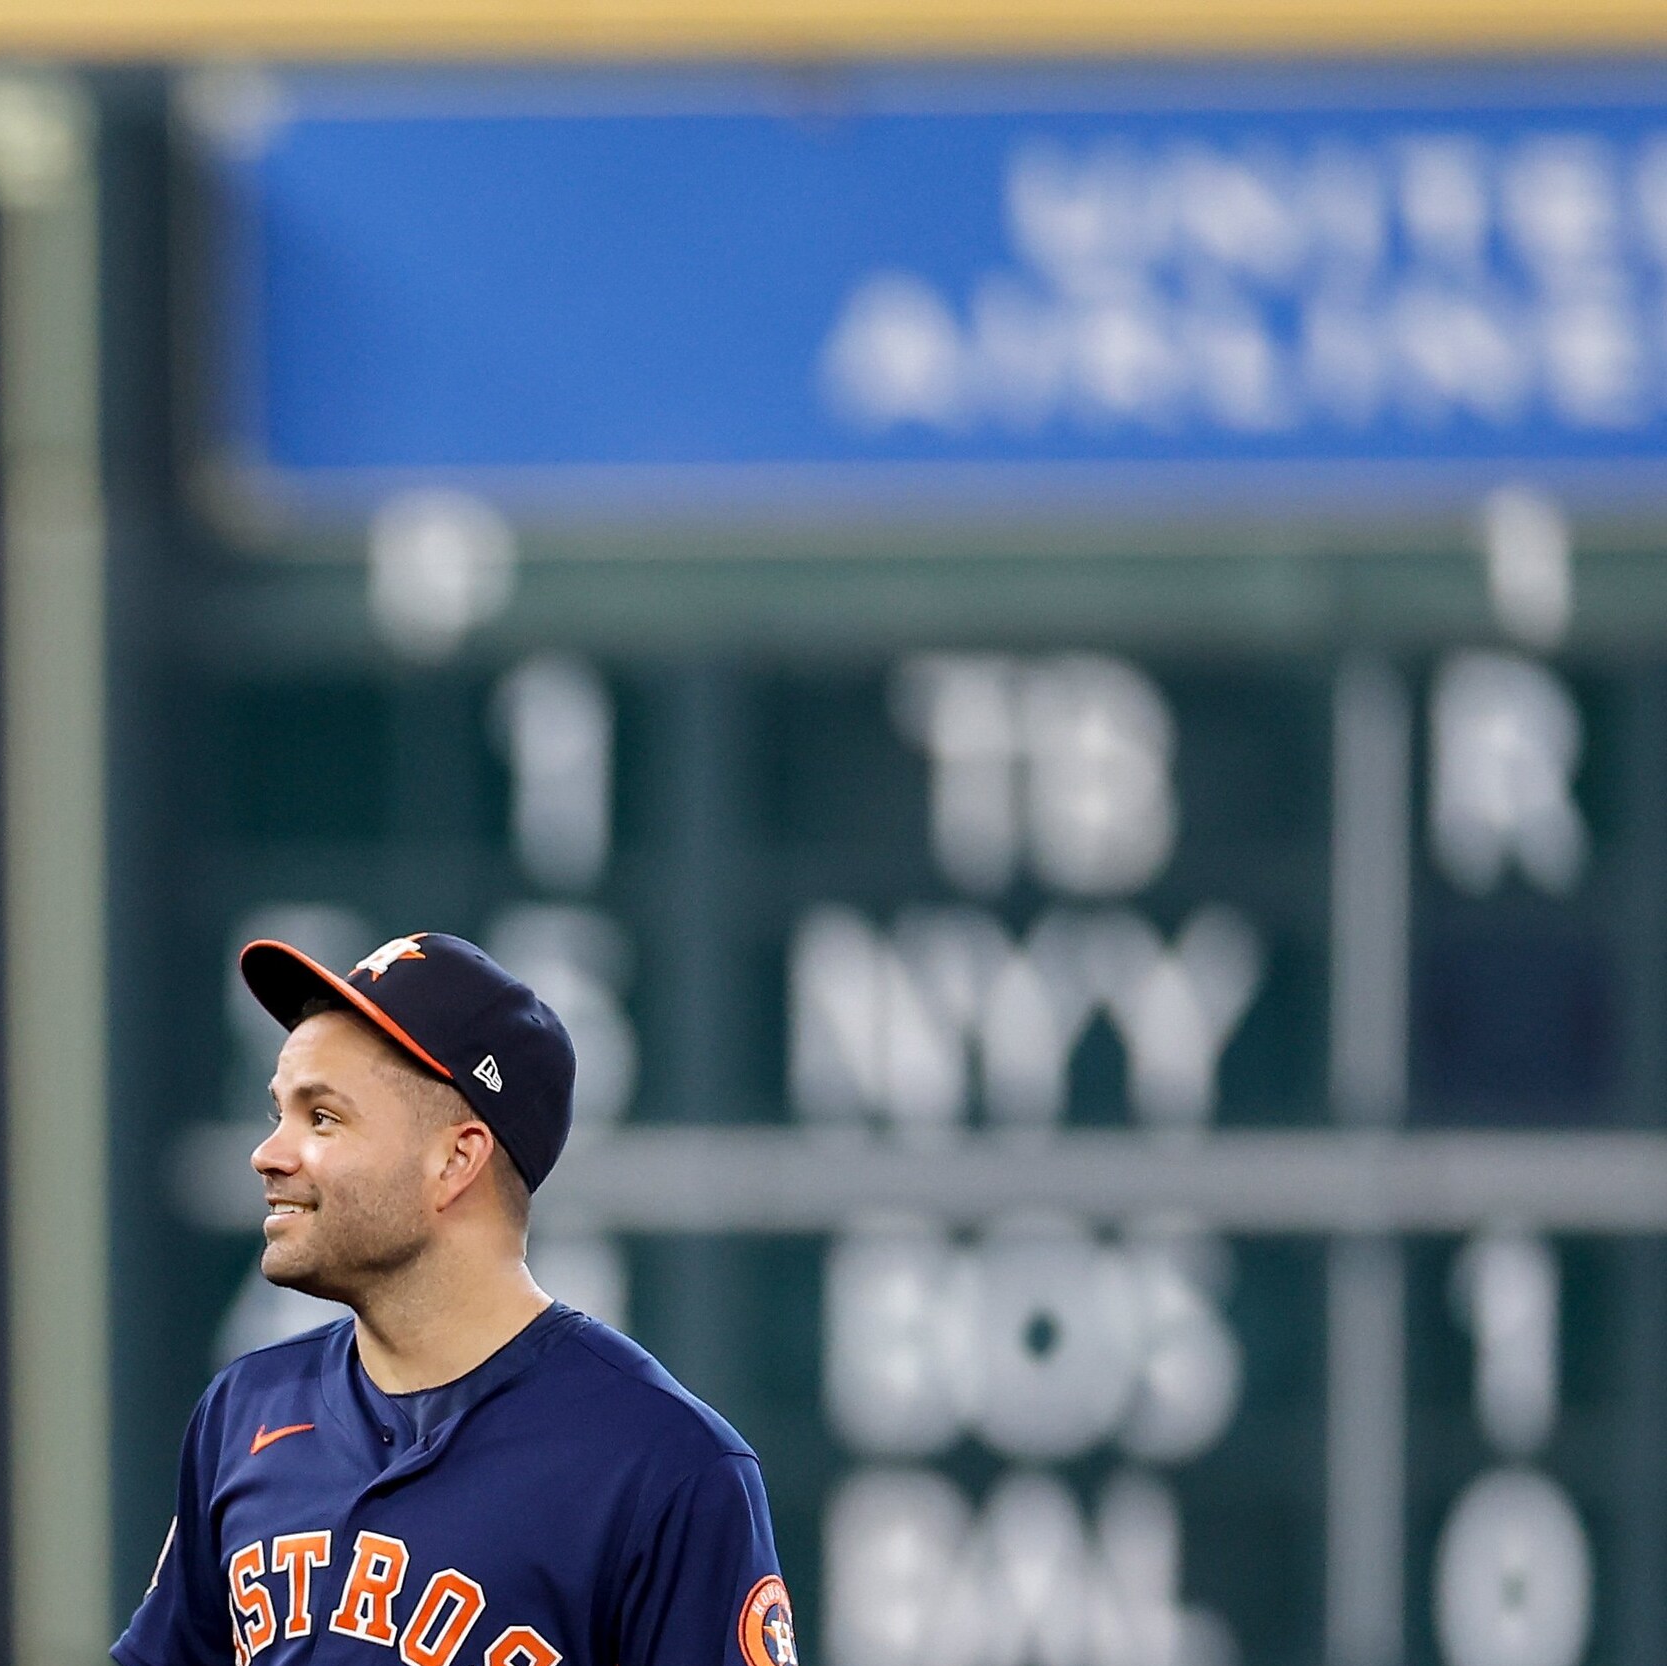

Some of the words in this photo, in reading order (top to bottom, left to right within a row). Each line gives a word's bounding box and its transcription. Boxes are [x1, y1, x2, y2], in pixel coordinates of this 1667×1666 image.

[1012, 138, 1667, 282] UNITE
[899, 652, 1175, 892] TB
[792, 903, 1255, 1130] NYY
[825, 1218, 1240, 1462] BOS
